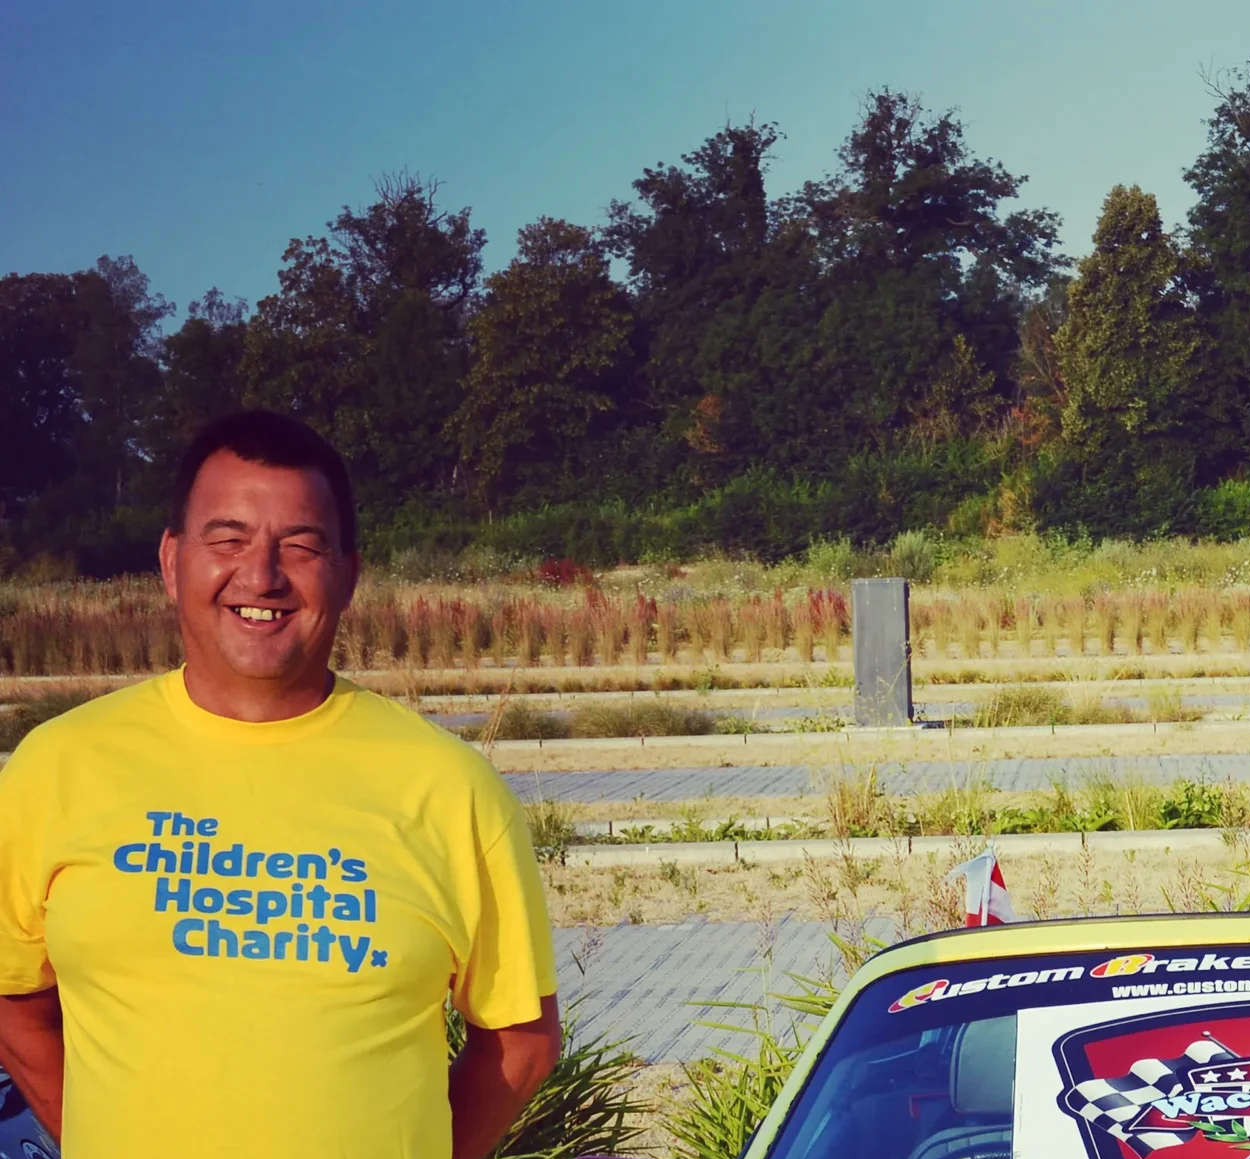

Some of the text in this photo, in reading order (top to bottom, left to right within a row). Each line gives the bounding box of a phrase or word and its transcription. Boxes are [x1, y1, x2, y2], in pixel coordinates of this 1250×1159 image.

[146, 811, 219, 837] The
[113, 841, 368, 881] Children's
[154, 877, 377, 925] Hospital
[172, 917, 370, 973] Charity
[888, 966, 1085, 1013] Custom
